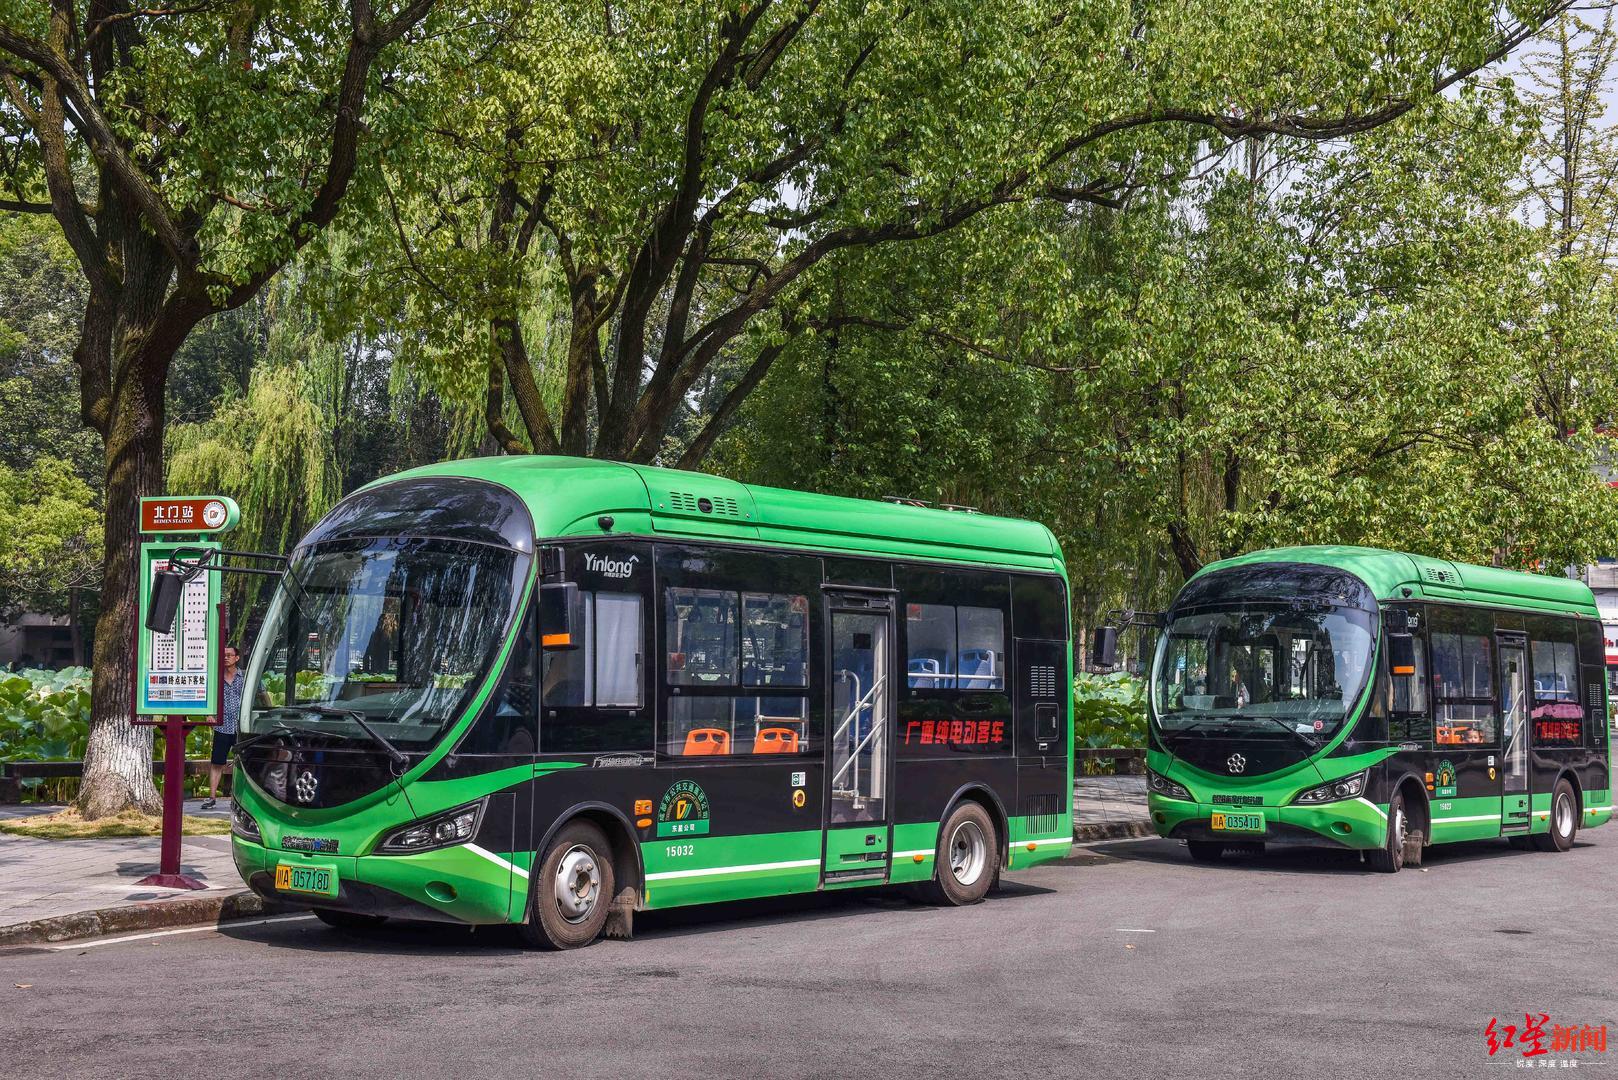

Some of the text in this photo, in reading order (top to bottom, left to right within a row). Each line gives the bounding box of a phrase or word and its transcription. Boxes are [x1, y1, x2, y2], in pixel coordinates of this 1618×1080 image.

[154, 505, 194, 519] 北门站
[584, 552, 633, 578] Yinlong
[168, 675, 205, 686] 终点站下客处
[905, 720, 1004, 744] 广通纯电动客车
[665, 845, 694, 857] 15032
